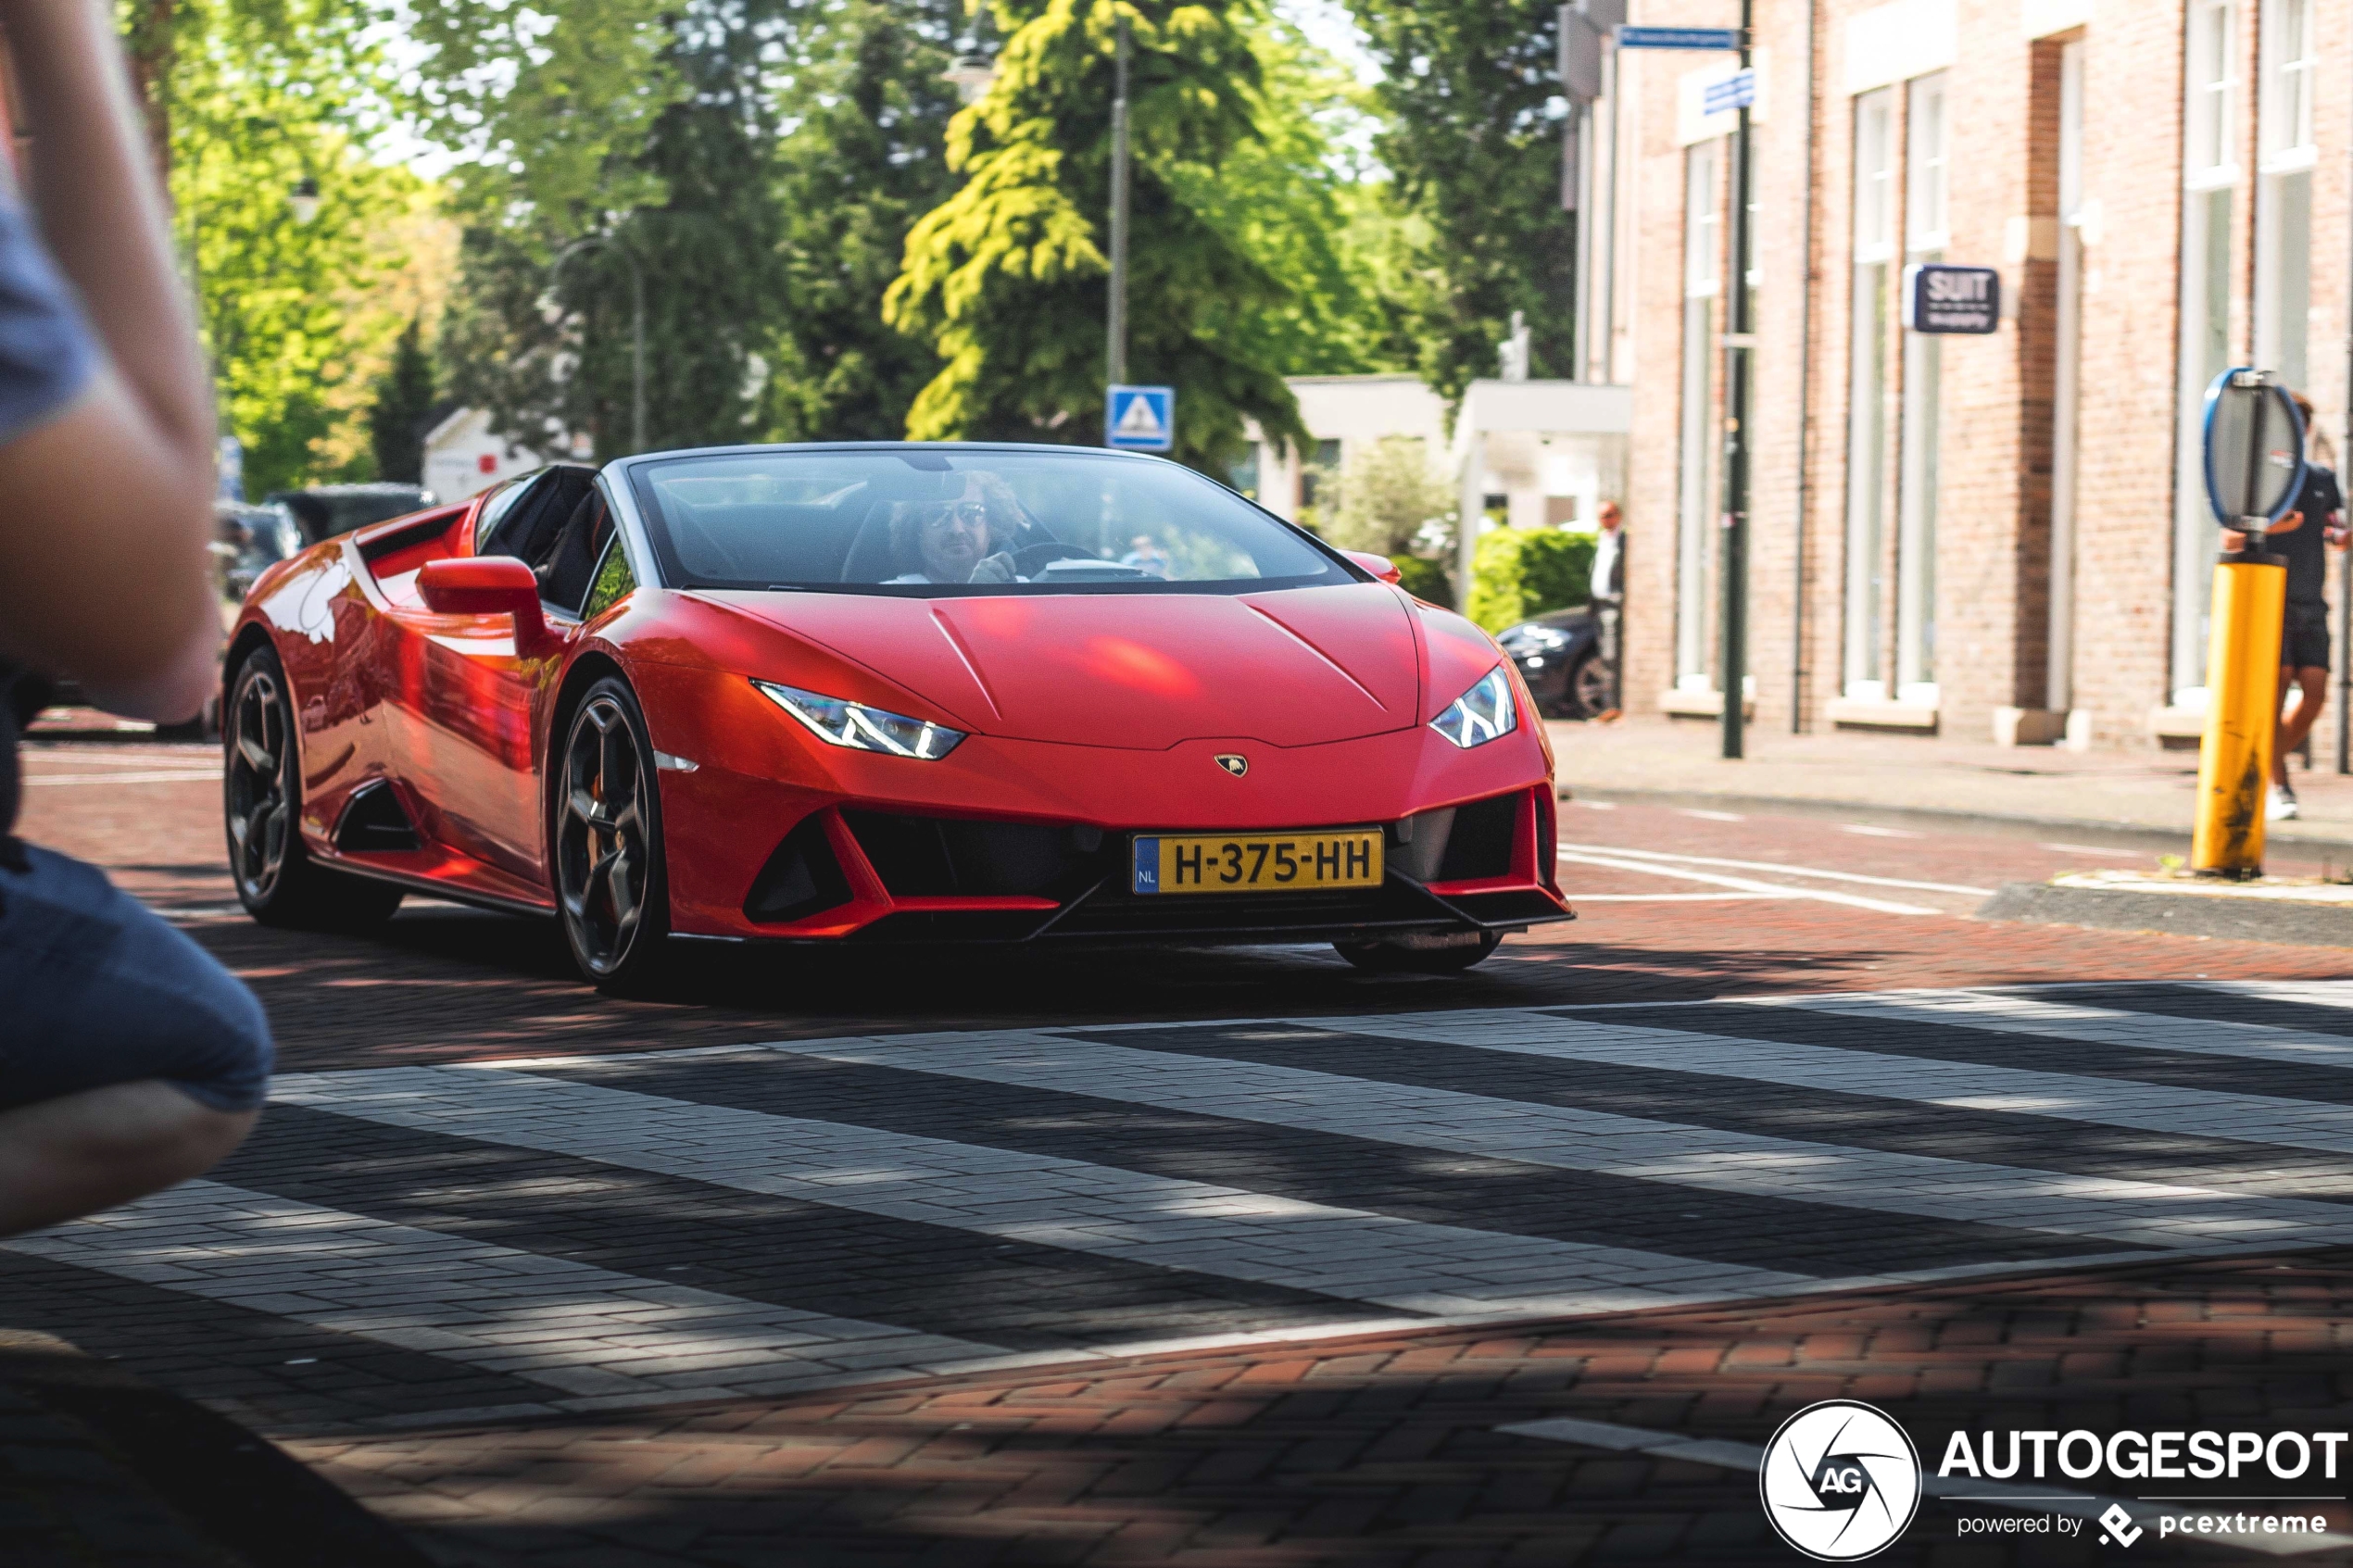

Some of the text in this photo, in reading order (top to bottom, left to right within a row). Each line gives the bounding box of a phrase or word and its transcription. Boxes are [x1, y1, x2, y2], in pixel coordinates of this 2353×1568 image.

[1928, 271, 1991, 300] SUIT
[1176, 839, 1369, 884] H-375-HH
[1139, 871, 1155, 884] NL
